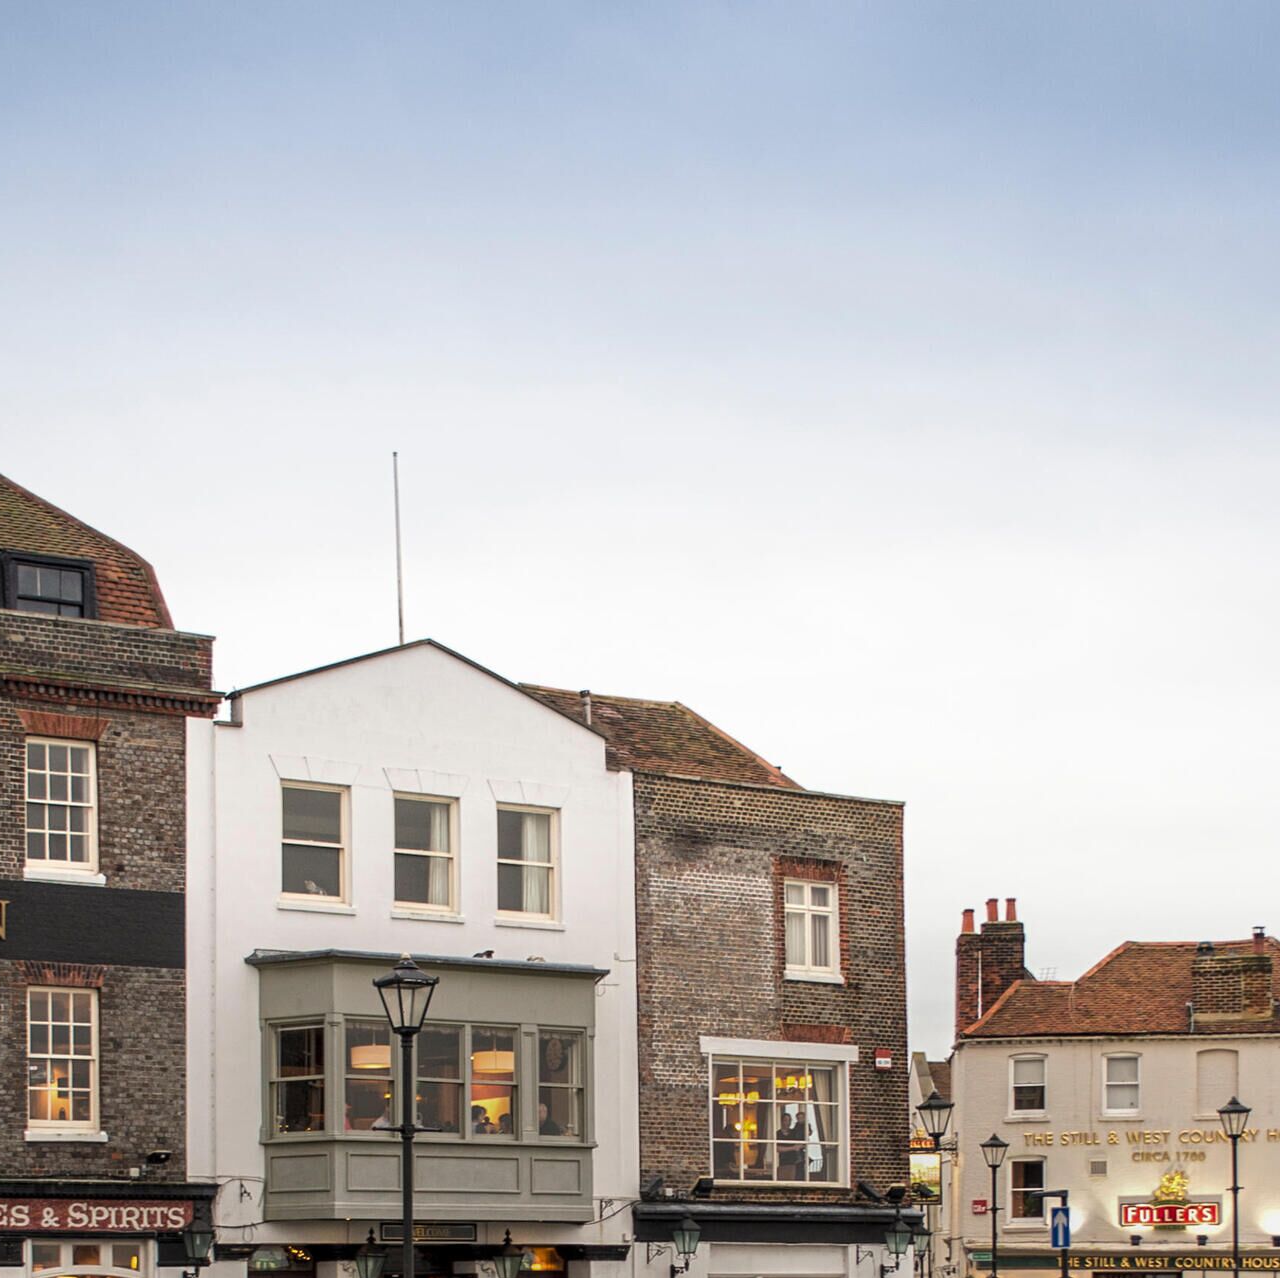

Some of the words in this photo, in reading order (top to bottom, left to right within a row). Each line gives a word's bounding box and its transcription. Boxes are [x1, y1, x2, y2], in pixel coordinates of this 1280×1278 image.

[1023, 1132, 1055, 1147] THE
[1060, 1131, 1101, 1146] STILL
[1107, 1130, 1120, 1145] &
[1126, 1129, 1170, 1145] WEST
[1178, 1128, 1260, 1144] COUNRY
[1131, 1151, 1170, 1162] CIRCA
[40, 1206, 61, 1228] &
[67, 1202, 186, 1231] SPIRITS
[1127, 1206, 1213, 1223] FULLER'S
[1085, 1256, 1116, 1268] STILL
[1120, 1256, 1131, 1268] &
[1135, 1256, 1169, 1268] WEST
